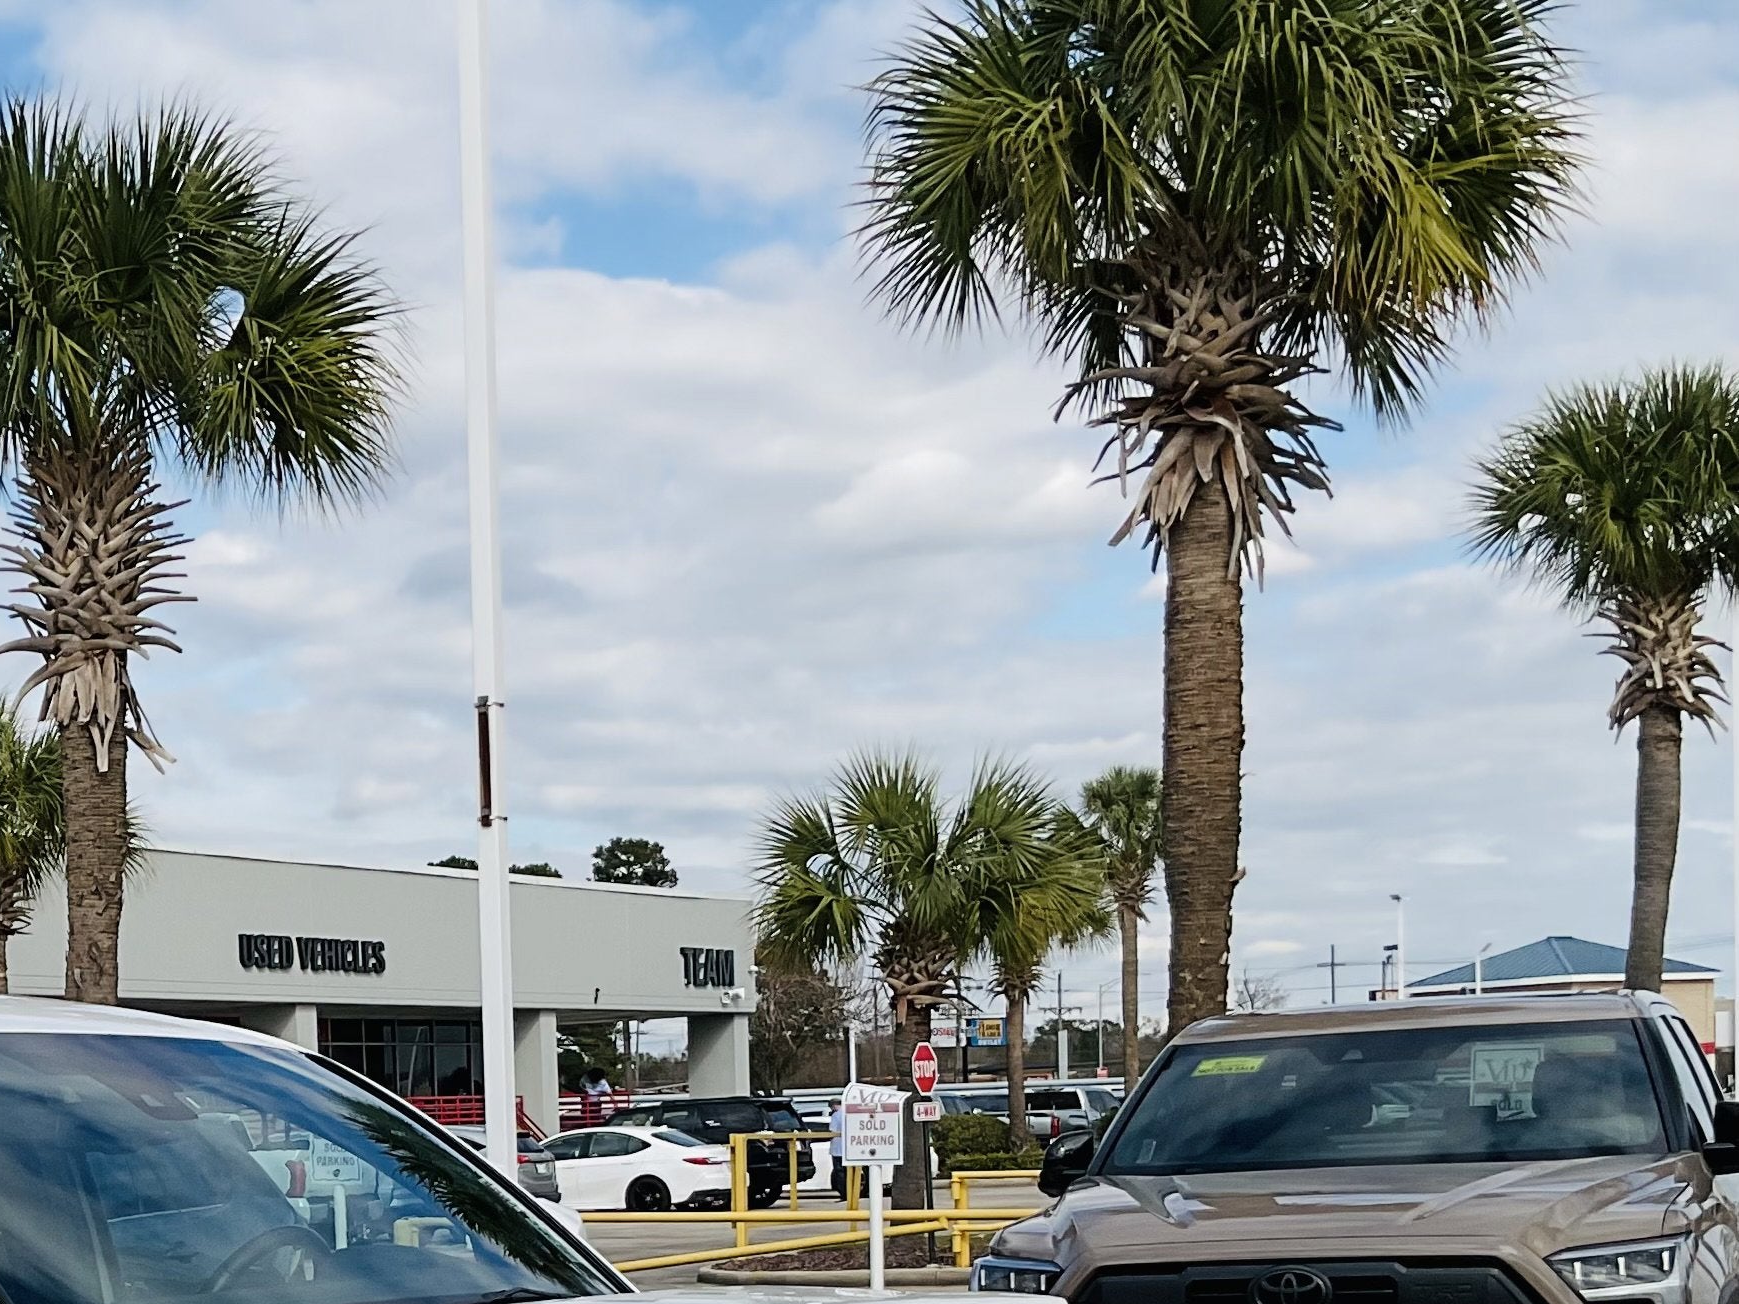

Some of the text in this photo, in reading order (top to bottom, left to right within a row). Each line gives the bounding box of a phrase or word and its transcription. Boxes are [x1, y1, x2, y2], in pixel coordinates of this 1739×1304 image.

[237, 934, 386, 974] USED VEHICLES
[679, 946, 735, 987] TEAM
[914, 1060, 936, 1078] STOP
[916, 1105, 937, 1118] 4-WAY
[858, 1119, 886, 1131] SOLD
[850, 1135, 895, 1146] PARKING
